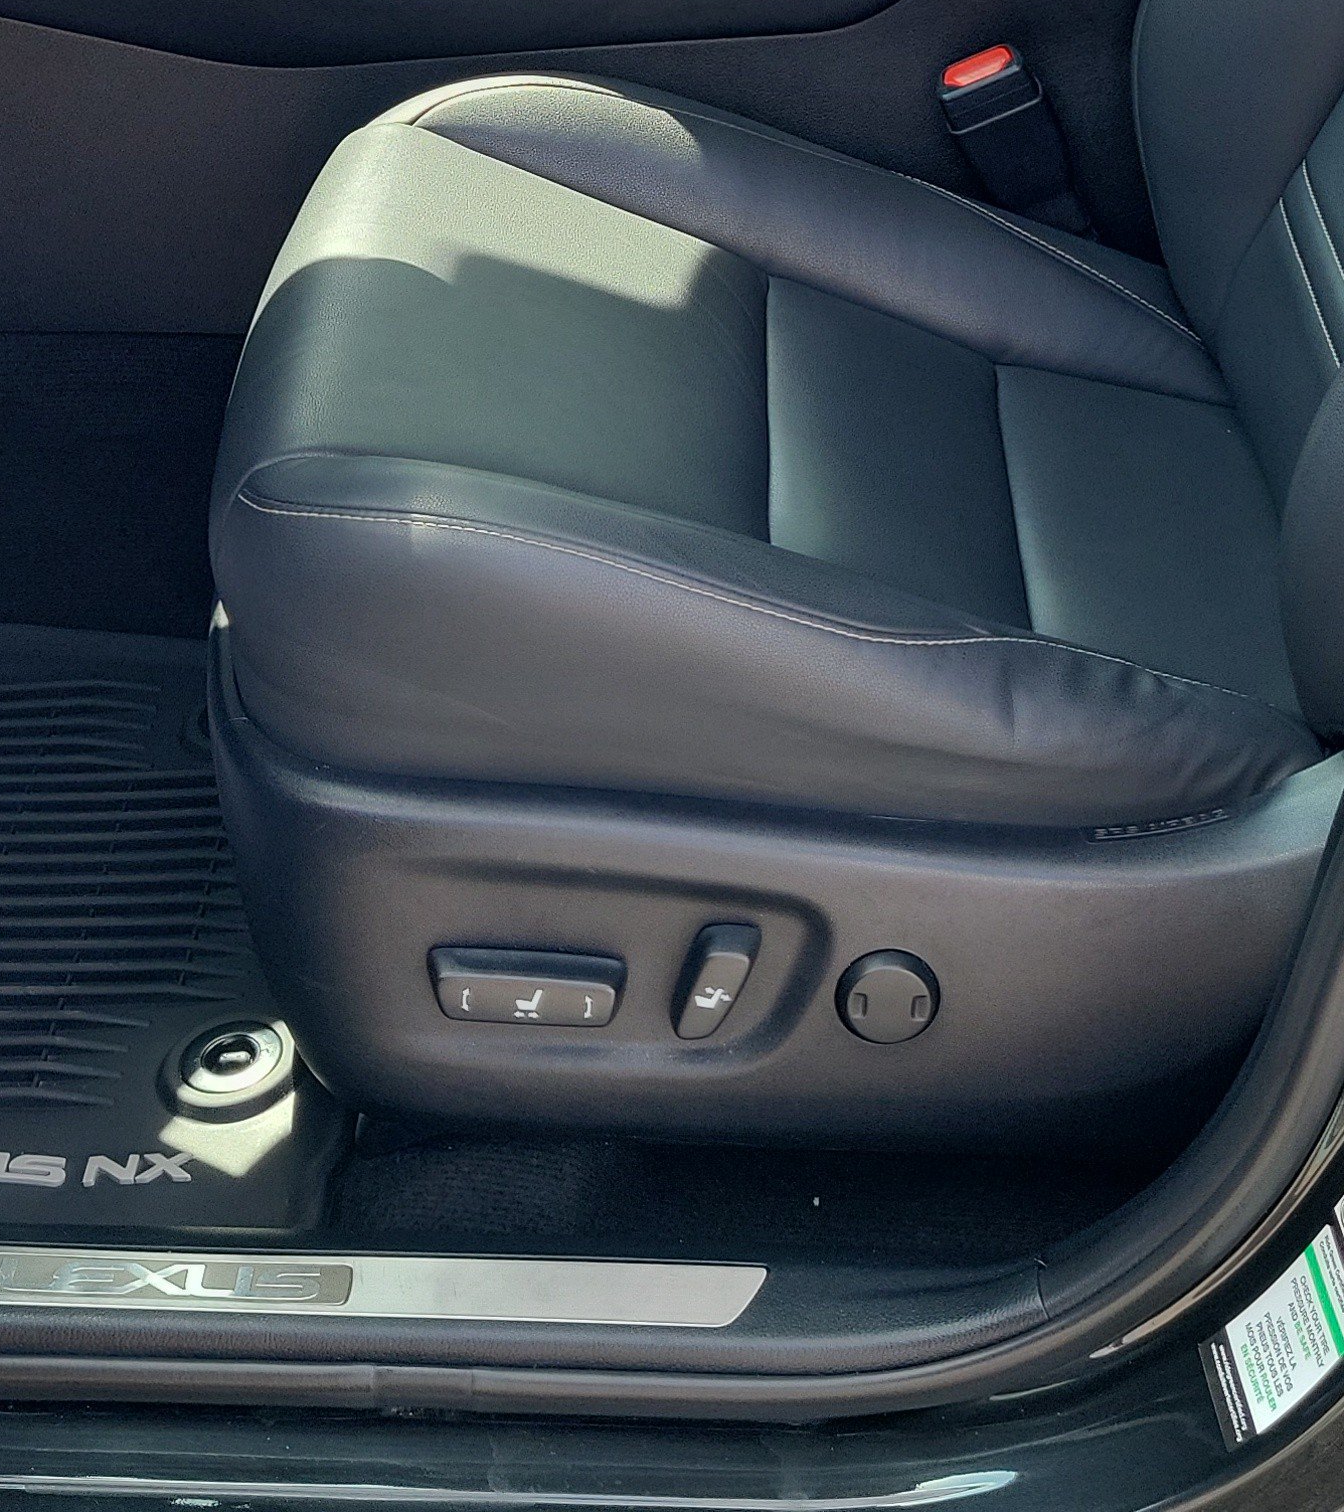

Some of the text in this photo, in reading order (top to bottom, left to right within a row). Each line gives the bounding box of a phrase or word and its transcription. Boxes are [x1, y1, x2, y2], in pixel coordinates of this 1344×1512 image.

[82, 1153, 194, 1187] NX
[1262, 1311, 1294, 1393] PRESSION DE VOS
[1274, 1314, 1297, 1371] VÉRIFIEZ LA
[1287, 1300, 1312, 1361] AND BE SAFE
[1289, 1276, 1326, 1369] PRESSURE MONTHLY
[1298, 1274, 1331, 1356] CHECK YOUR TIRE
[1239, 1342, 1266, 1405] EN SÉCURITÉ
[1244, 1320, 1278, 1412] MOIS POUR ROULER
[1254, 1320, 1284, 1398] PNEUS TOUS LES
